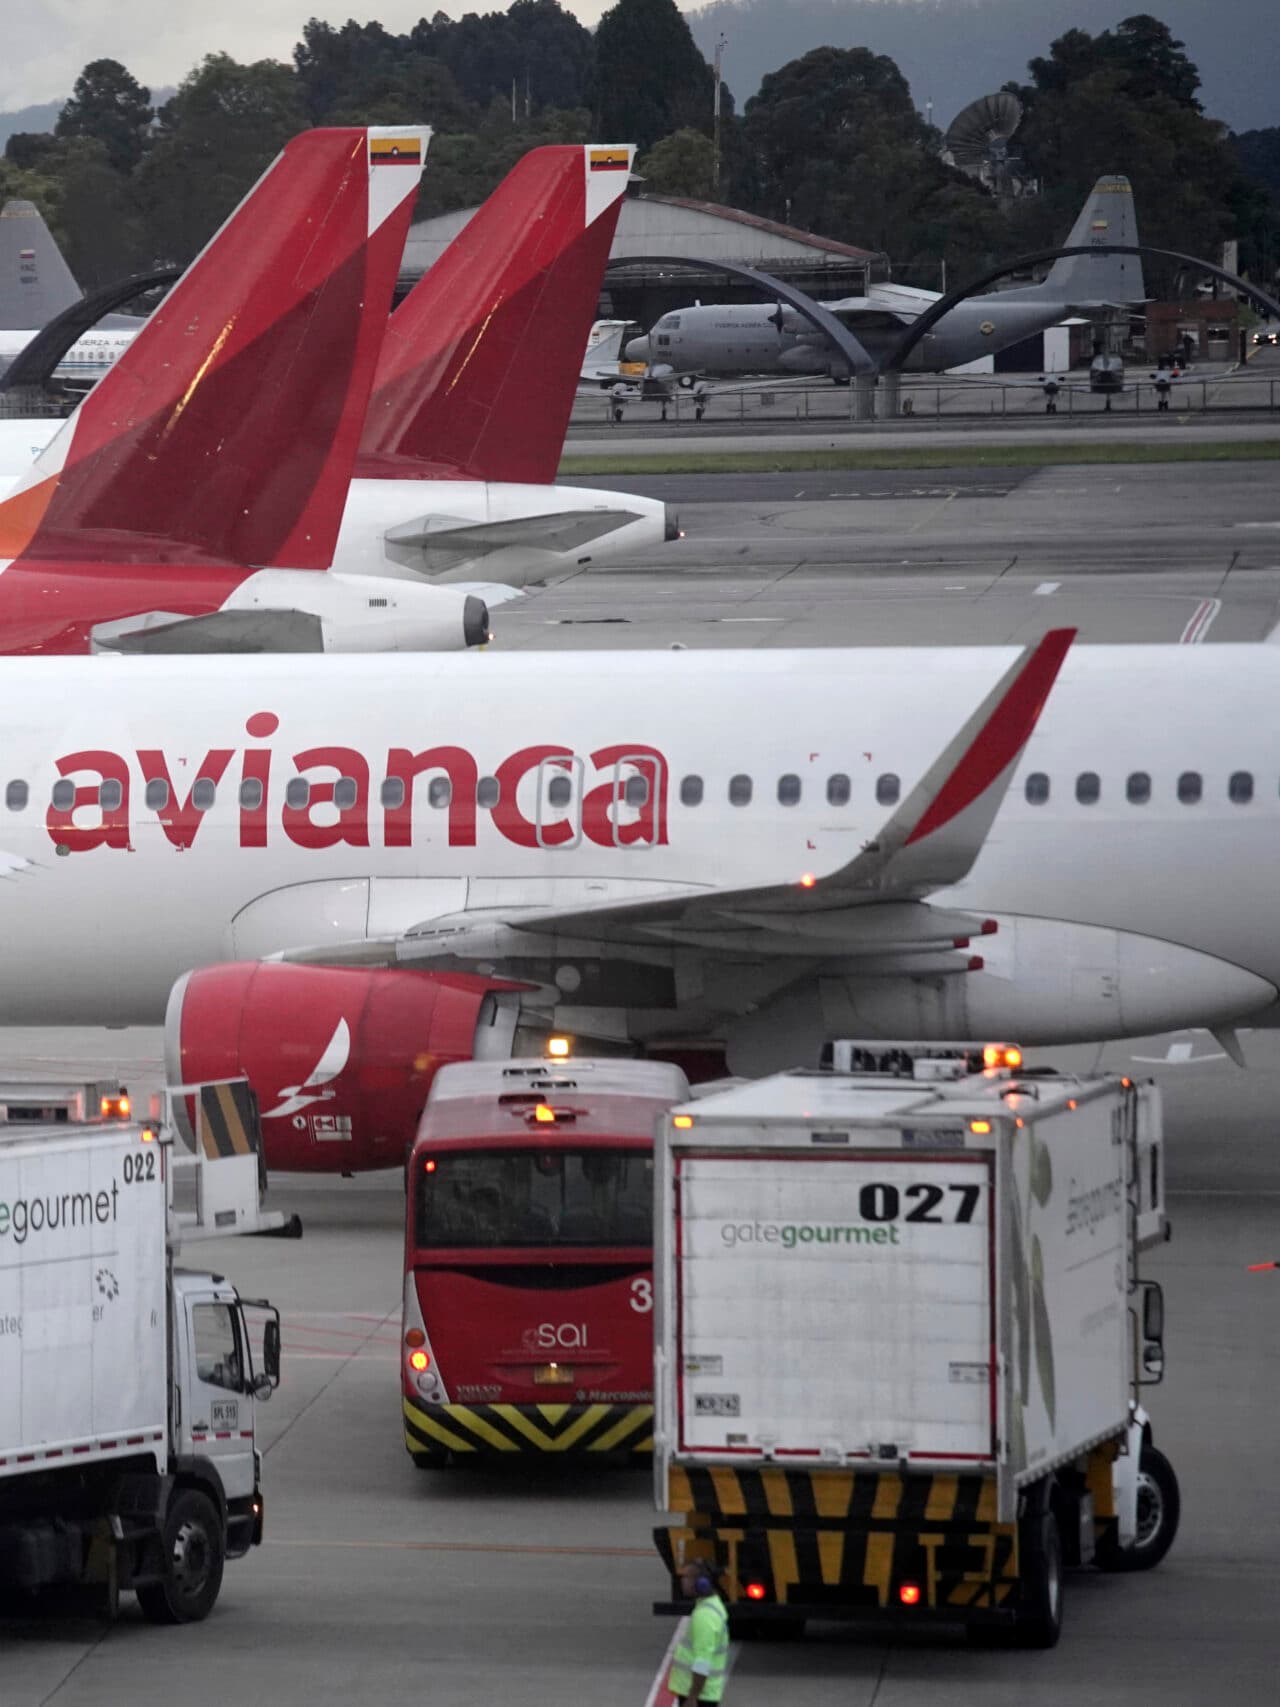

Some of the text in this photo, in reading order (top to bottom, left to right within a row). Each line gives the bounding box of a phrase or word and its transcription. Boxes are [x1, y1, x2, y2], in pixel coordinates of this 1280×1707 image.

[46, 711, 669, 852] avianca
[123, 1151, 155, 1184] 022
[859, 1183, 980, 1223] 027
[721, 1221, 900, 1248] gategourmet
[630, 1278, 653, 1313] 3
